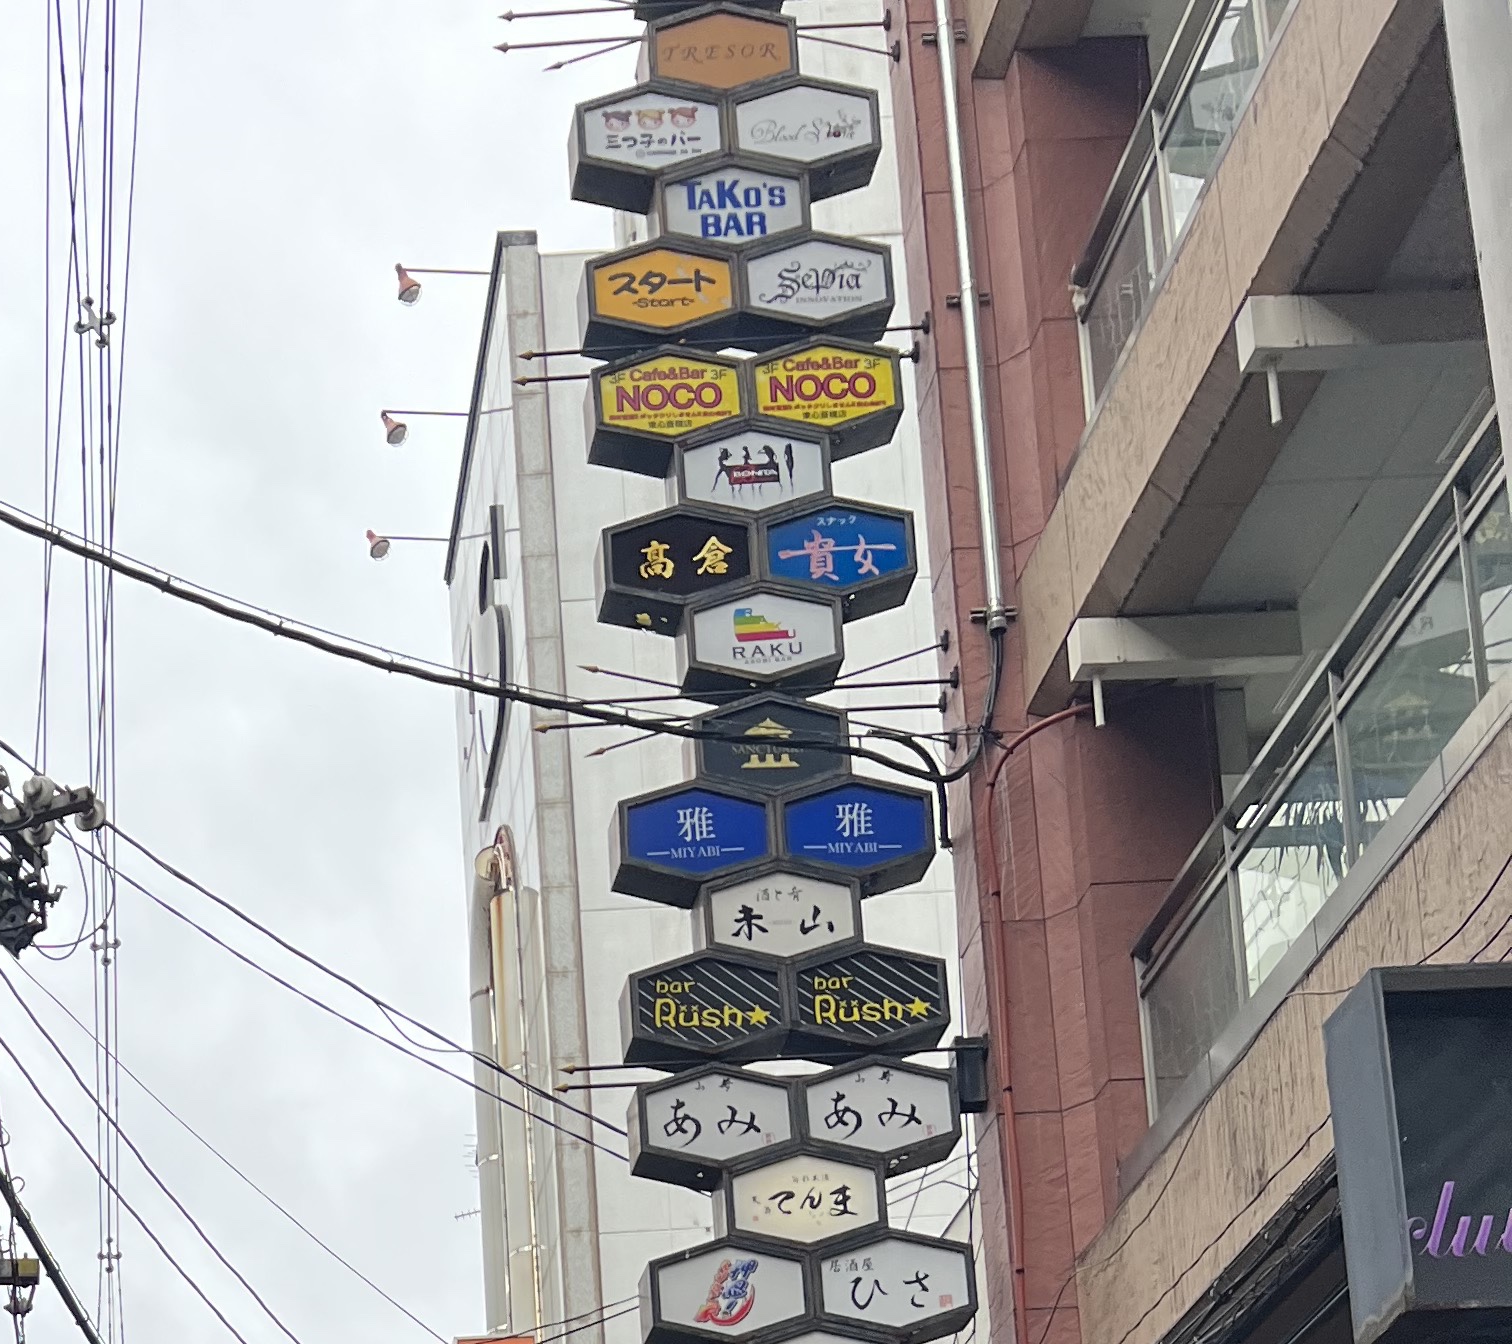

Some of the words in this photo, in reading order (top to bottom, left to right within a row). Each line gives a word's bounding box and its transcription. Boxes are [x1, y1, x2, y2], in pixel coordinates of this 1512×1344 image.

[662, 42, 780, 66] TRESOR
[605, 130, 702, 149] 三つ子のバー
[700, 211, 767, 238] BAR
[608, 268, 716, 296] スタート
[710, 369, 728, 380] 3F
[769, 371, 877, 403] NOCO
[616, 382, 723, 412] NOCO
[732, 641, 803, 660] RAKU
[676, 806, 716, 842] 雅
[835, 802, 874, 838] 雅
[670, 845, 721, 860] MIYABI
[827, 841, 879, 855] MIYABI
[656, 979, 696, 995] bar
[813, 974, 854, 991] bar
[663, 1098, 762, 1149] あみ
[824, 1091, 923, 1141] あみ
[829, 1257, 875, 1273] 居酒屋
[849, 1270, 931, 1311] ひさ
